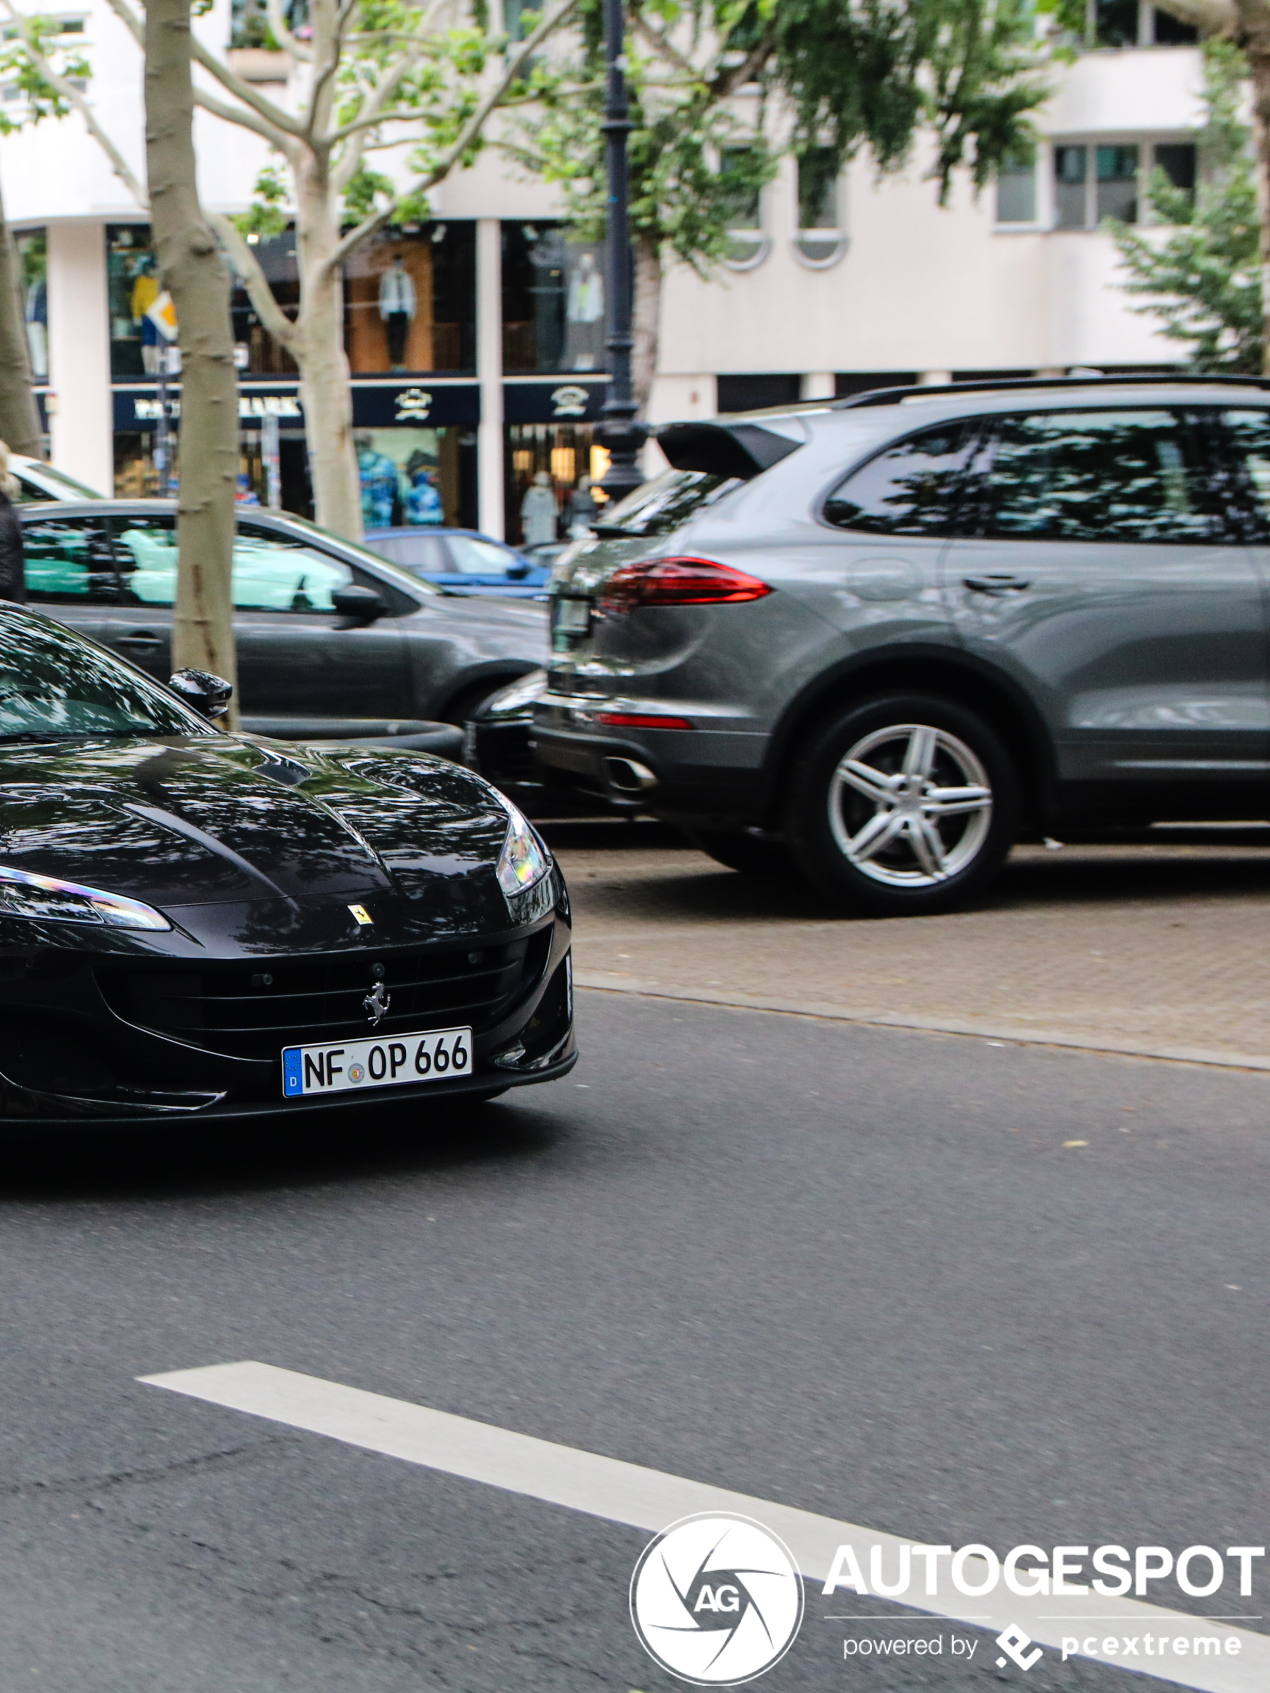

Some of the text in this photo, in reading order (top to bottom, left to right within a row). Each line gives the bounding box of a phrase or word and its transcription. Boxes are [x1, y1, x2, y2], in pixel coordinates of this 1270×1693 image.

[304, 1035, 468, 1088] NF OP 666
[289, 1076, 298, 1087] D
